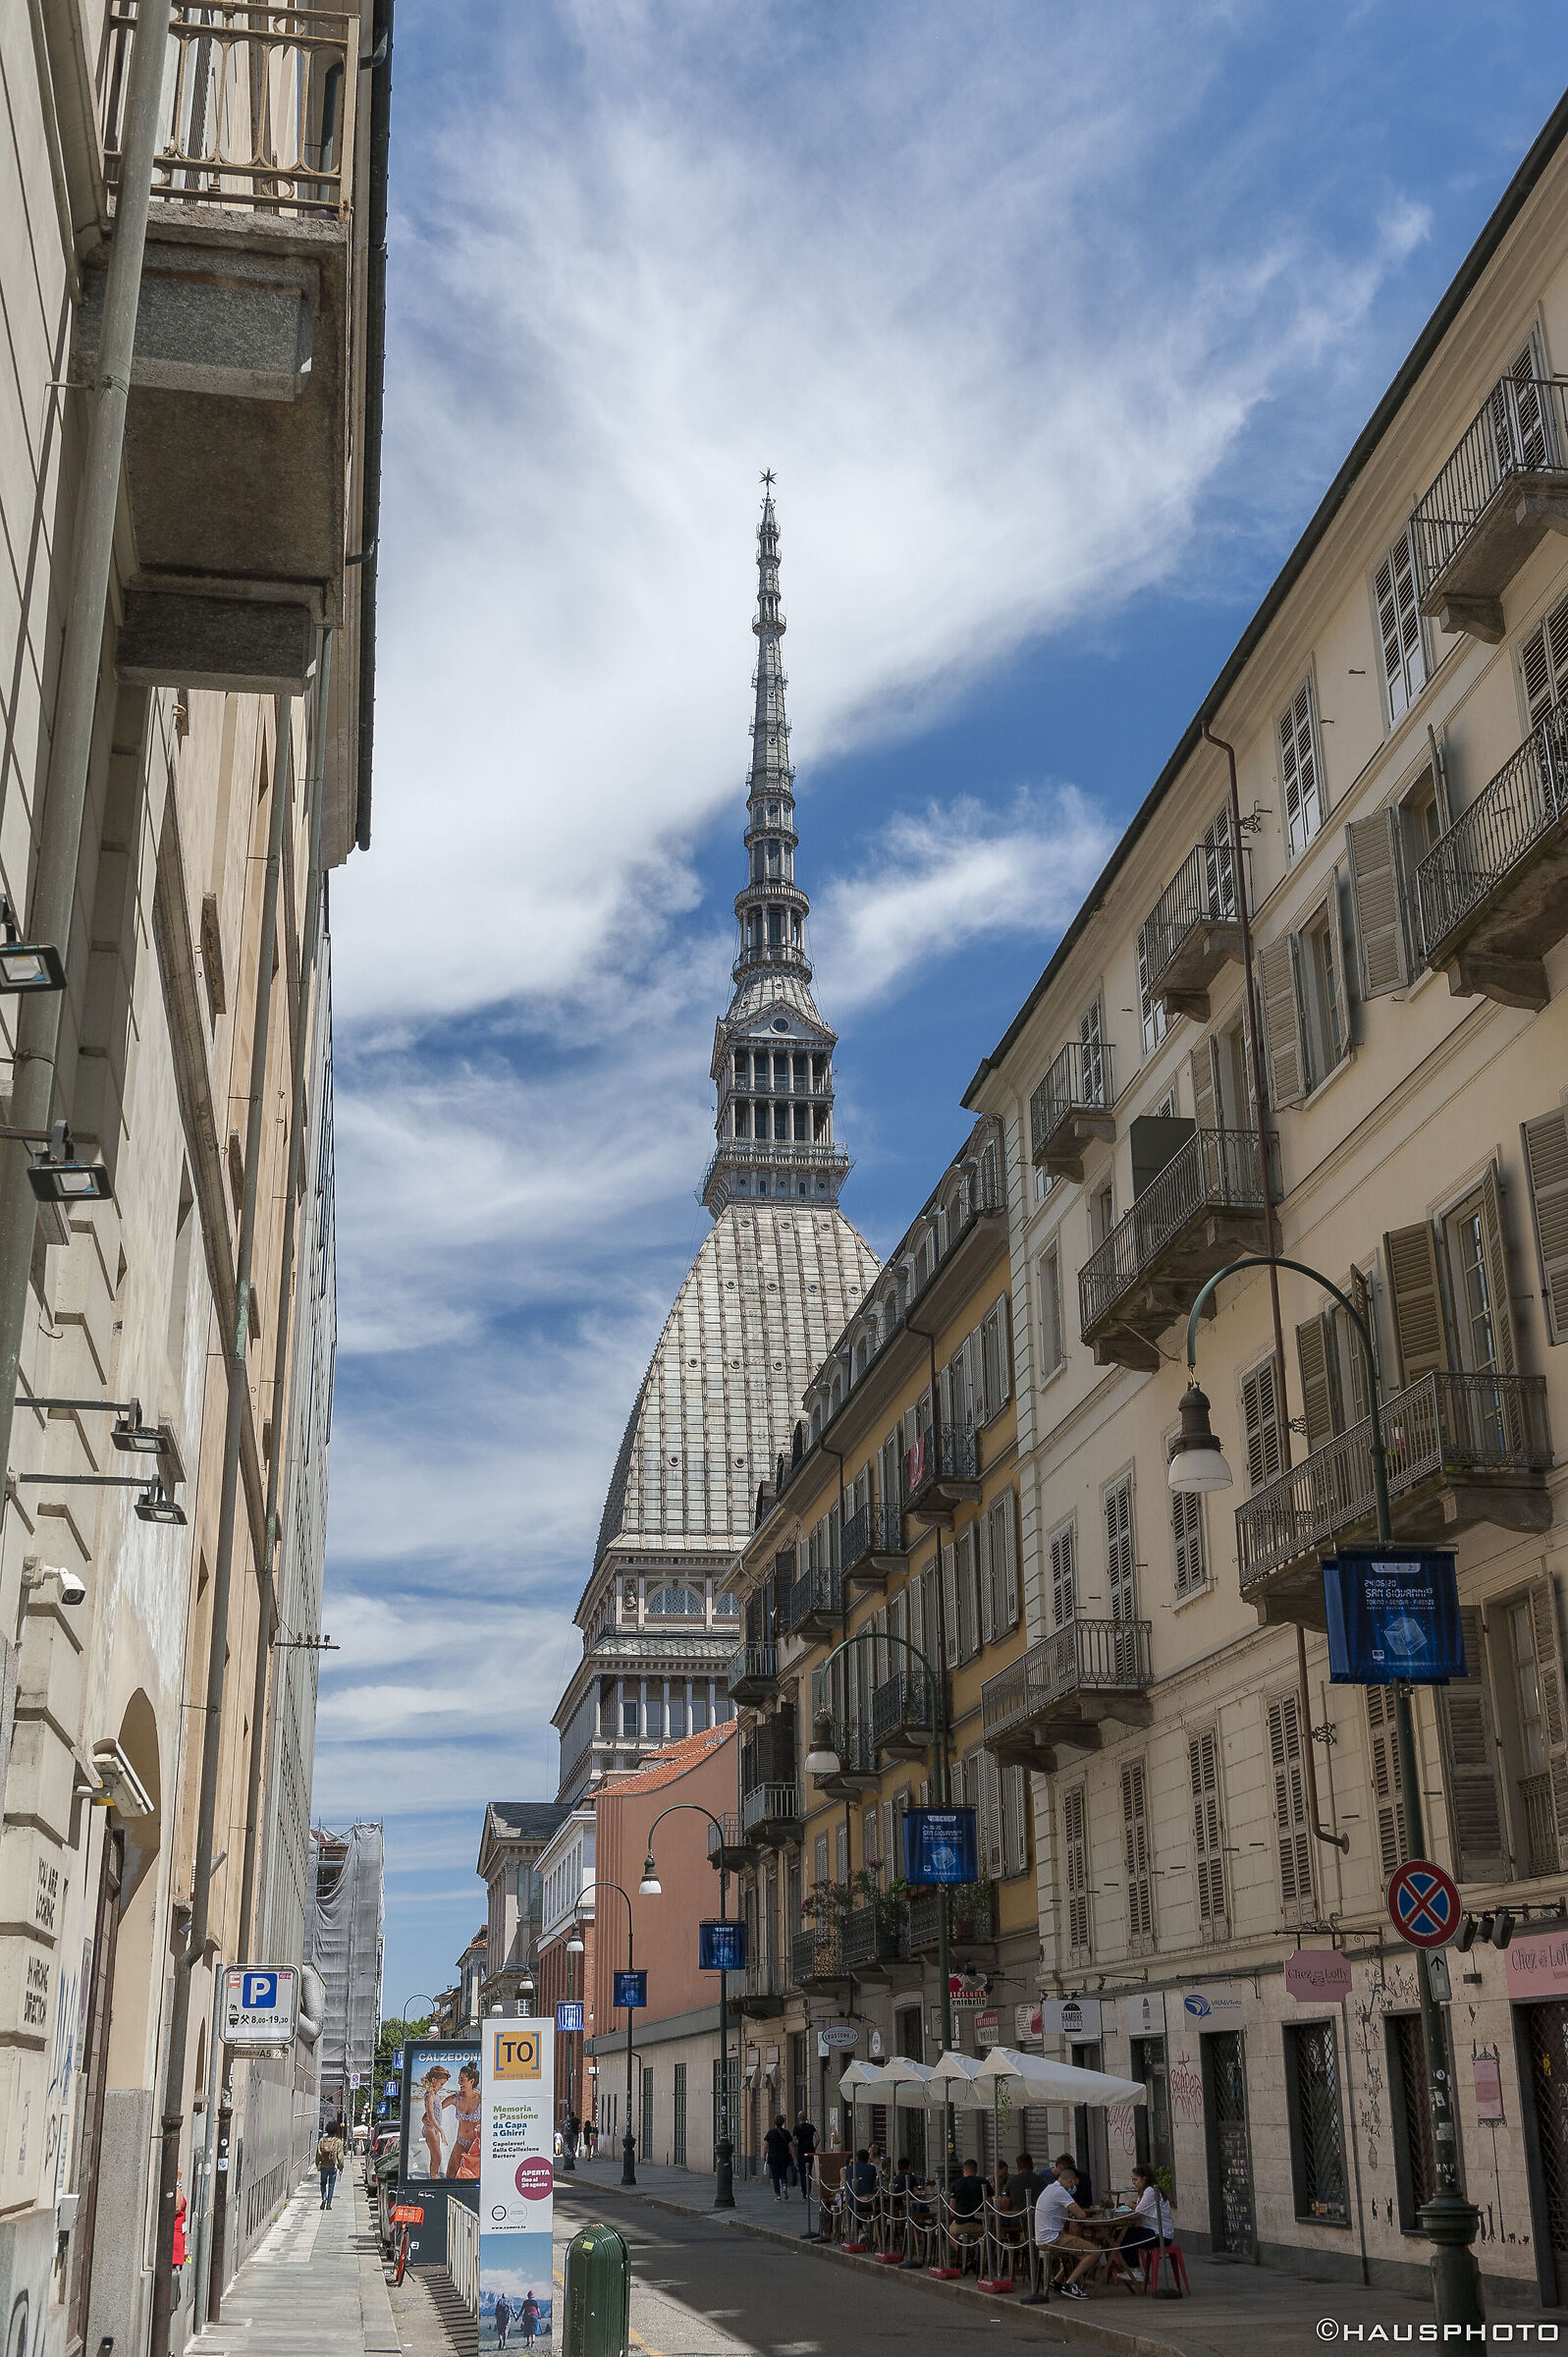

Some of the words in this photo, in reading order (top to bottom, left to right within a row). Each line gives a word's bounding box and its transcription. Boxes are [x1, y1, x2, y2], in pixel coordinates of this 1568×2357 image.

[1366, 1589, 1383, 1598] SAN
[1512, 1948, 1538, 1972] Chez
[1287, 1969, 1312, 1979] Chez
[1325, 1968, 1348, 1980] Lolly
[249, 1977, 271, 2004] P
[258, 2050, 272, 2058] A5
[493, 2105, 532, 2113] Memoria
[505, 2121, 527, 2130] Capa
